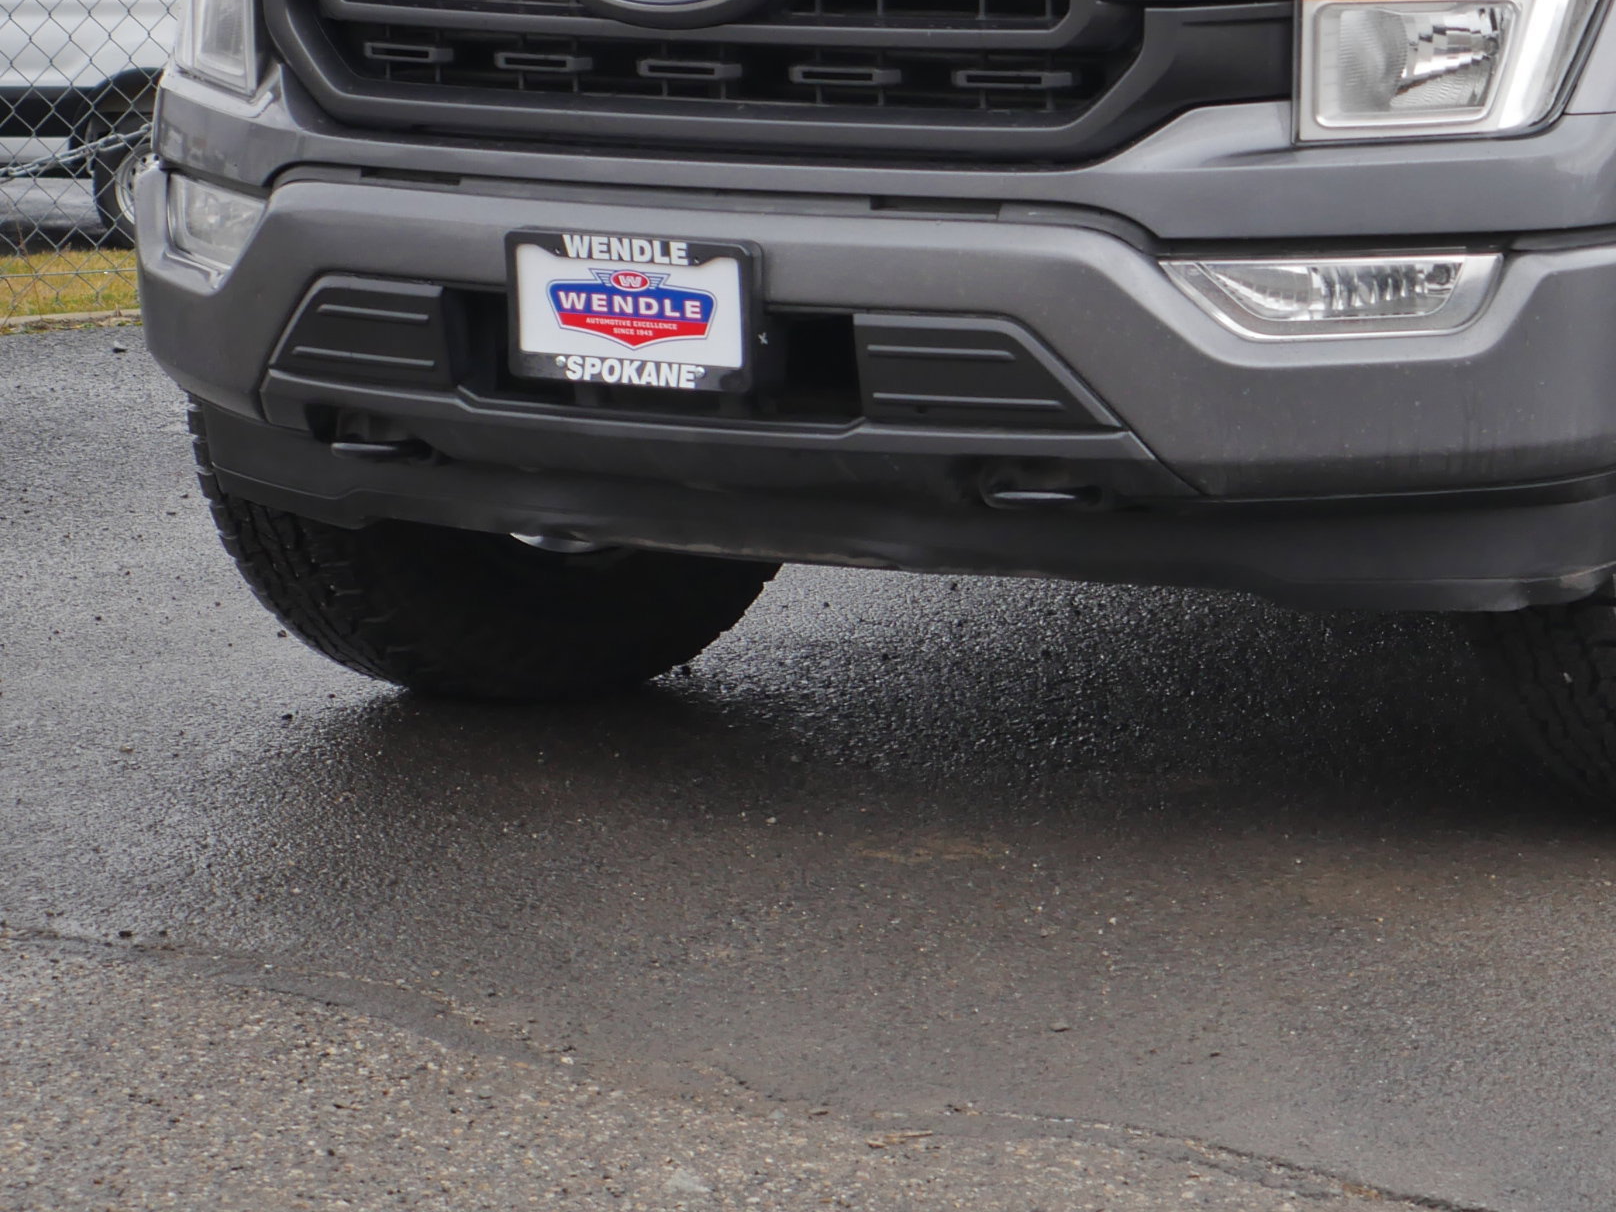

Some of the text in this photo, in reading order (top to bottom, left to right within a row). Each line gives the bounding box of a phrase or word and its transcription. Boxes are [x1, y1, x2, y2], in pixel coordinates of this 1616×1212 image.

[562, 234, 689, 266] WENDLE
[558, 291, 702, 319] WENDLE
[586, 317, 678, 330] AUTOMOTIVE EXCELLENCE
[613, 327, 635, 335] SINCE
[565, 355, 696, 389] SPOKANE
